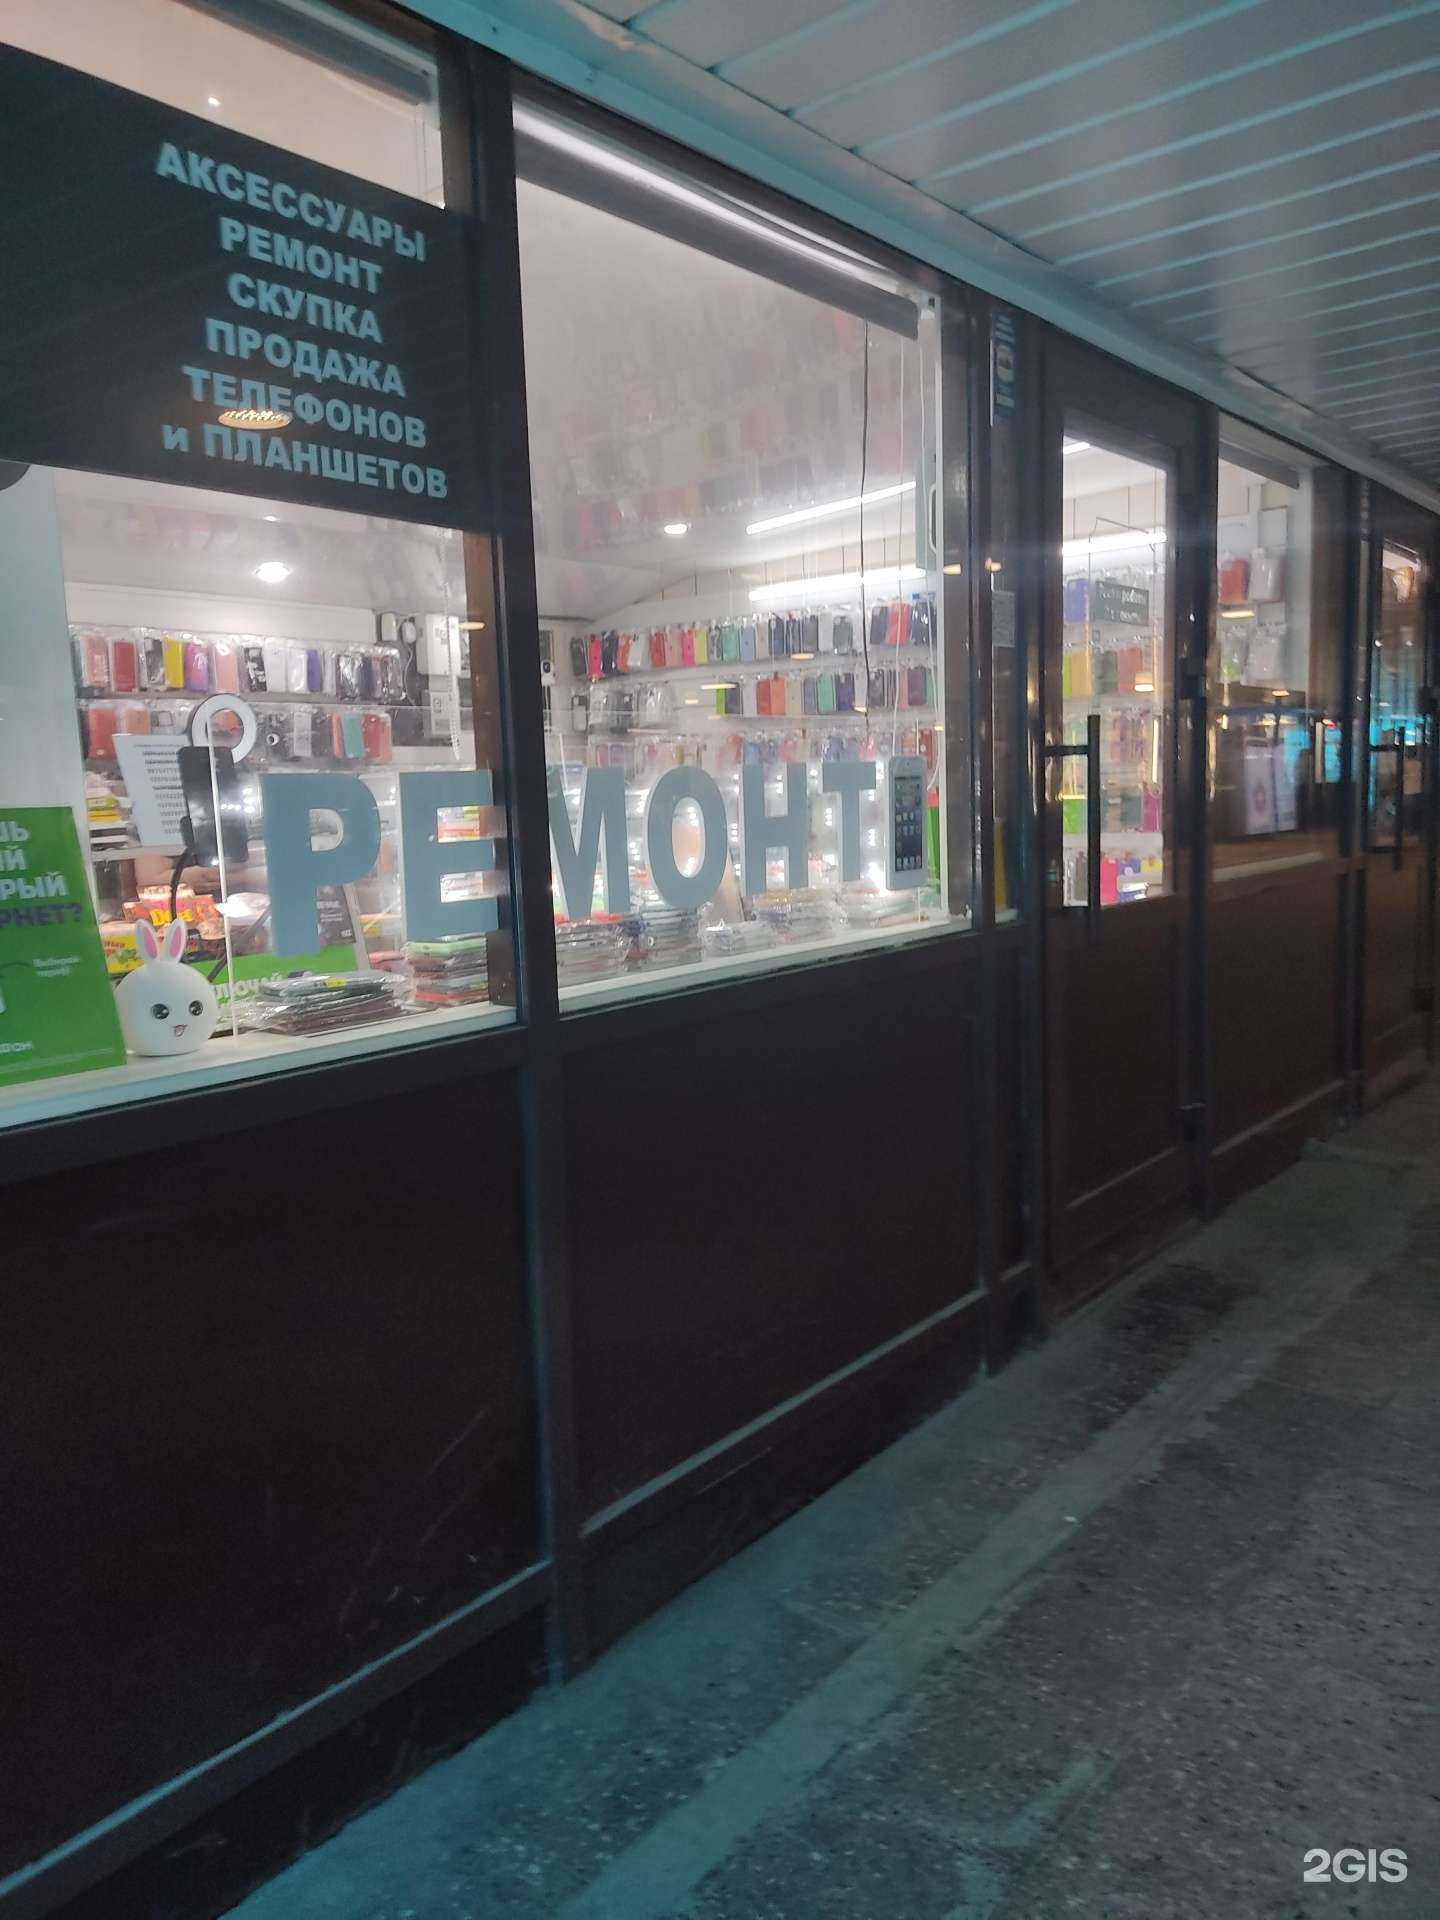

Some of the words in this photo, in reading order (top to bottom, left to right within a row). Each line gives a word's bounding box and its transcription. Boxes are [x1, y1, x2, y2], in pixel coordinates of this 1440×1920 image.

[155, 143, 426, 262] АКСЕССУАРЫ
[219, 217, 383, 293] РЕМОНТ
[227, 272, 383, 344] СКУПКА
[205, 318, 406, 398] ПРОДАЖА
[181, 365, 427, 448] ТЕЛЕФОНОВ
[204, 424, 448, 498] ПЛАНШЕТОВ
[261, 762, 877, 956] РЕМОНТ
